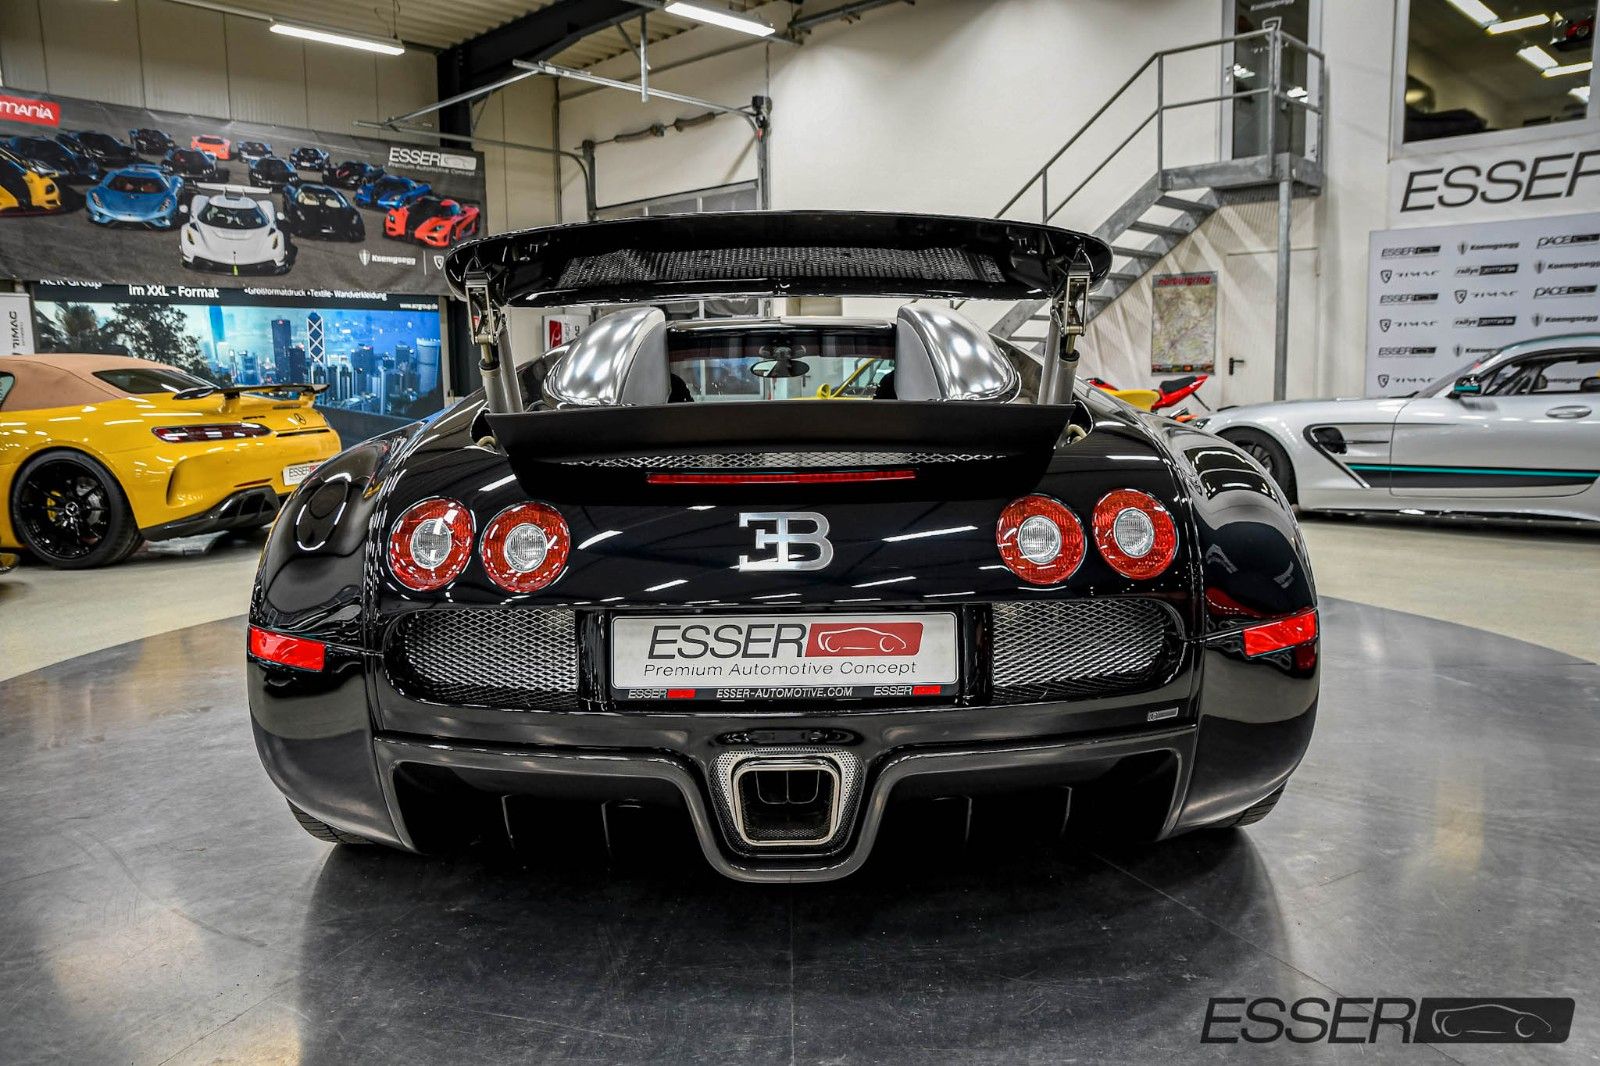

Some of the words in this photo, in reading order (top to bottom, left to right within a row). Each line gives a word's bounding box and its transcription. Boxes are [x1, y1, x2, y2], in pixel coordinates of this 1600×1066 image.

[389, 147, 441, 166] ESSER
[146, 284, 170, 297] XXL
[177, 285, 220, 298] Format
[647, 623, 807, 660] ESSER
[643, 663, 723, 677] Premium
[728, 661, 833, 676] Automotive
[839, 660, 918, 675] Concept
[628, 688, 668, 699] ESSER
[716, 686, 853, 699] ESSER-AUTOMOTIVE.COM
[873, 685, 913, 696] ESSER
